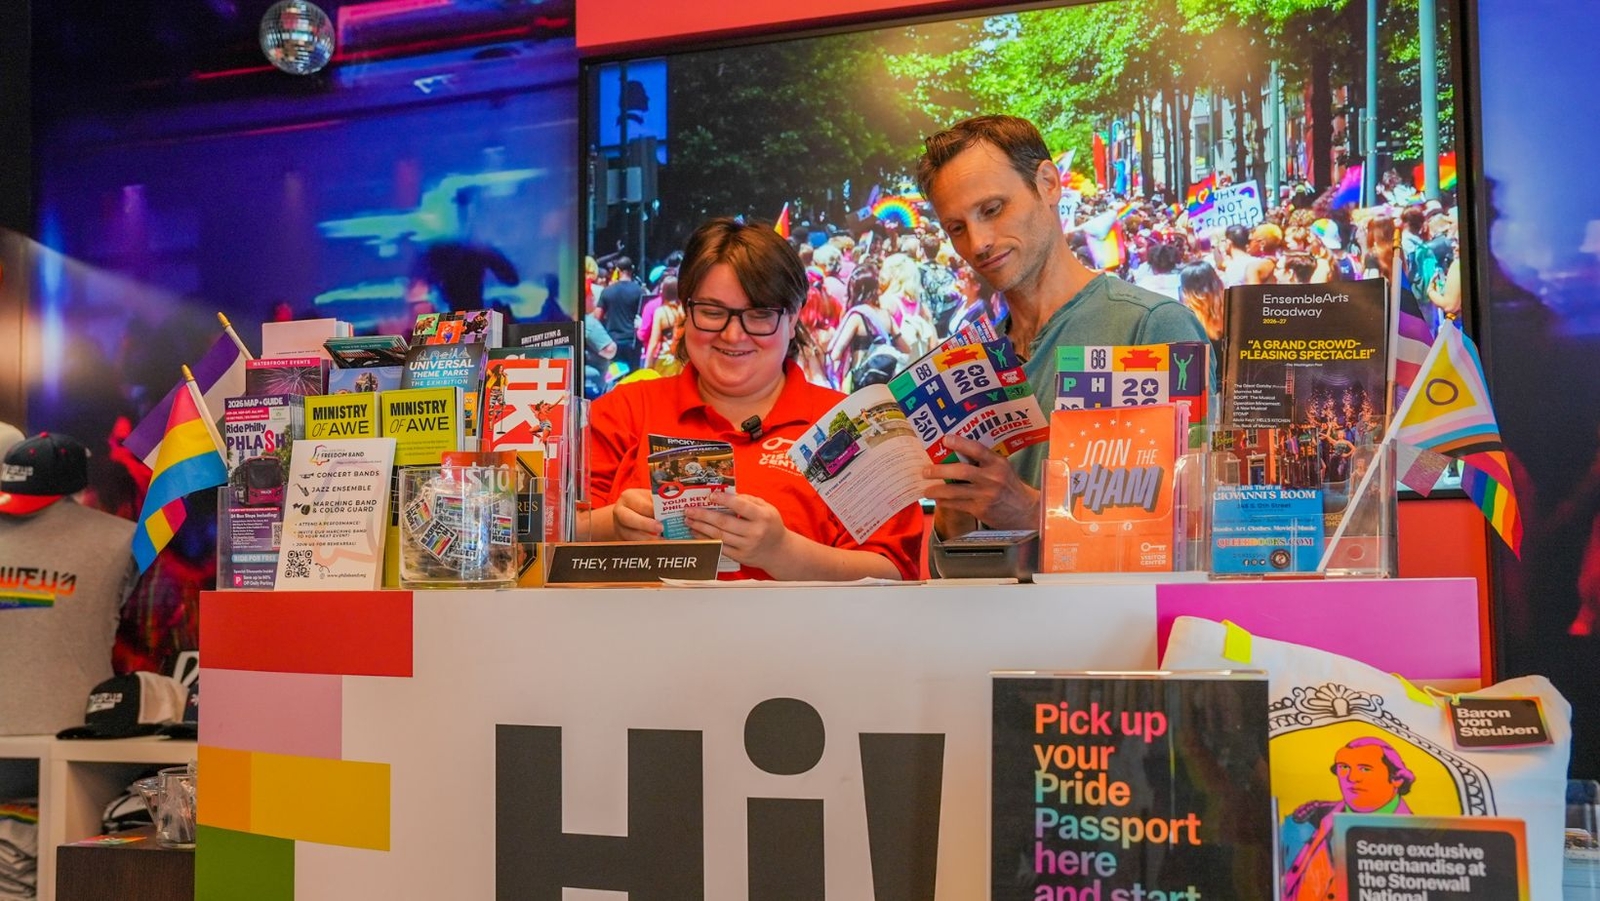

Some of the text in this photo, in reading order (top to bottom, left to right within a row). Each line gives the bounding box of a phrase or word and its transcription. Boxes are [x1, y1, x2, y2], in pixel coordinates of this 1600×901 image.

[1218, 200, 1243, 214] NOT
[1263, 293, 1349, 304] EnsembleArts
[1262, 307, 1322, 318] Broadway
[1263, 340, 1306, 350] GRAND
[1308, 339, 1361, 350] CROWD-
[1240, 350, 1297, 360] PLEASING
[409, 359, 475, 371] UNIVERSAL
[442, 369, 469, 377] PARKS
[1122, 378, 1159, 396] 20
[244, 398, 259, 407] MAP
[262, 397, 283, 406] GUIDE
[390, 400, 447, 416] MINISTRY
[313, 404, 367, 420] MINISTRY
[980, 409, 996, 419] IN
[226, 422, 267, 433] Ride Philly
[312, 420, 369, 437] OF AWE
[390, 416, 449, 434] OF AWE
[990, 419, 1032, 437] GUIDE
[226, 430, 286, 453] PHLASH
[1078, 438, 1158, 468] JOIN THE
[465, 462, 510, 492] $10
[661, 497, 687, 507] YOUR
[1280, 490, 1316, 499] ROOM
[571, 557, 697, 571] THEY, THEM, THEIR
[1456, 708, 1511, 719] Baron
[1035, 702, 1167, 743] Pick up
[1458, 718, 1492, 727] von
[1460, 725, 1539, 737] Steuben
[1034, 744, 1115, 775] your
[1035, 771, 1131, 806] Pride
[1035, 807, 1202, 849] Passport
[1034, 841, 1117, 876] here
[1356, 840, 1484, 861] Score exclusive
[1357, 858, 1487, 877] merchandise at
[1034, 879, 1201, 901] and start
[1357, 872, 1470, 892] the Stonewall
[1358, 888, 1428, 901] National
